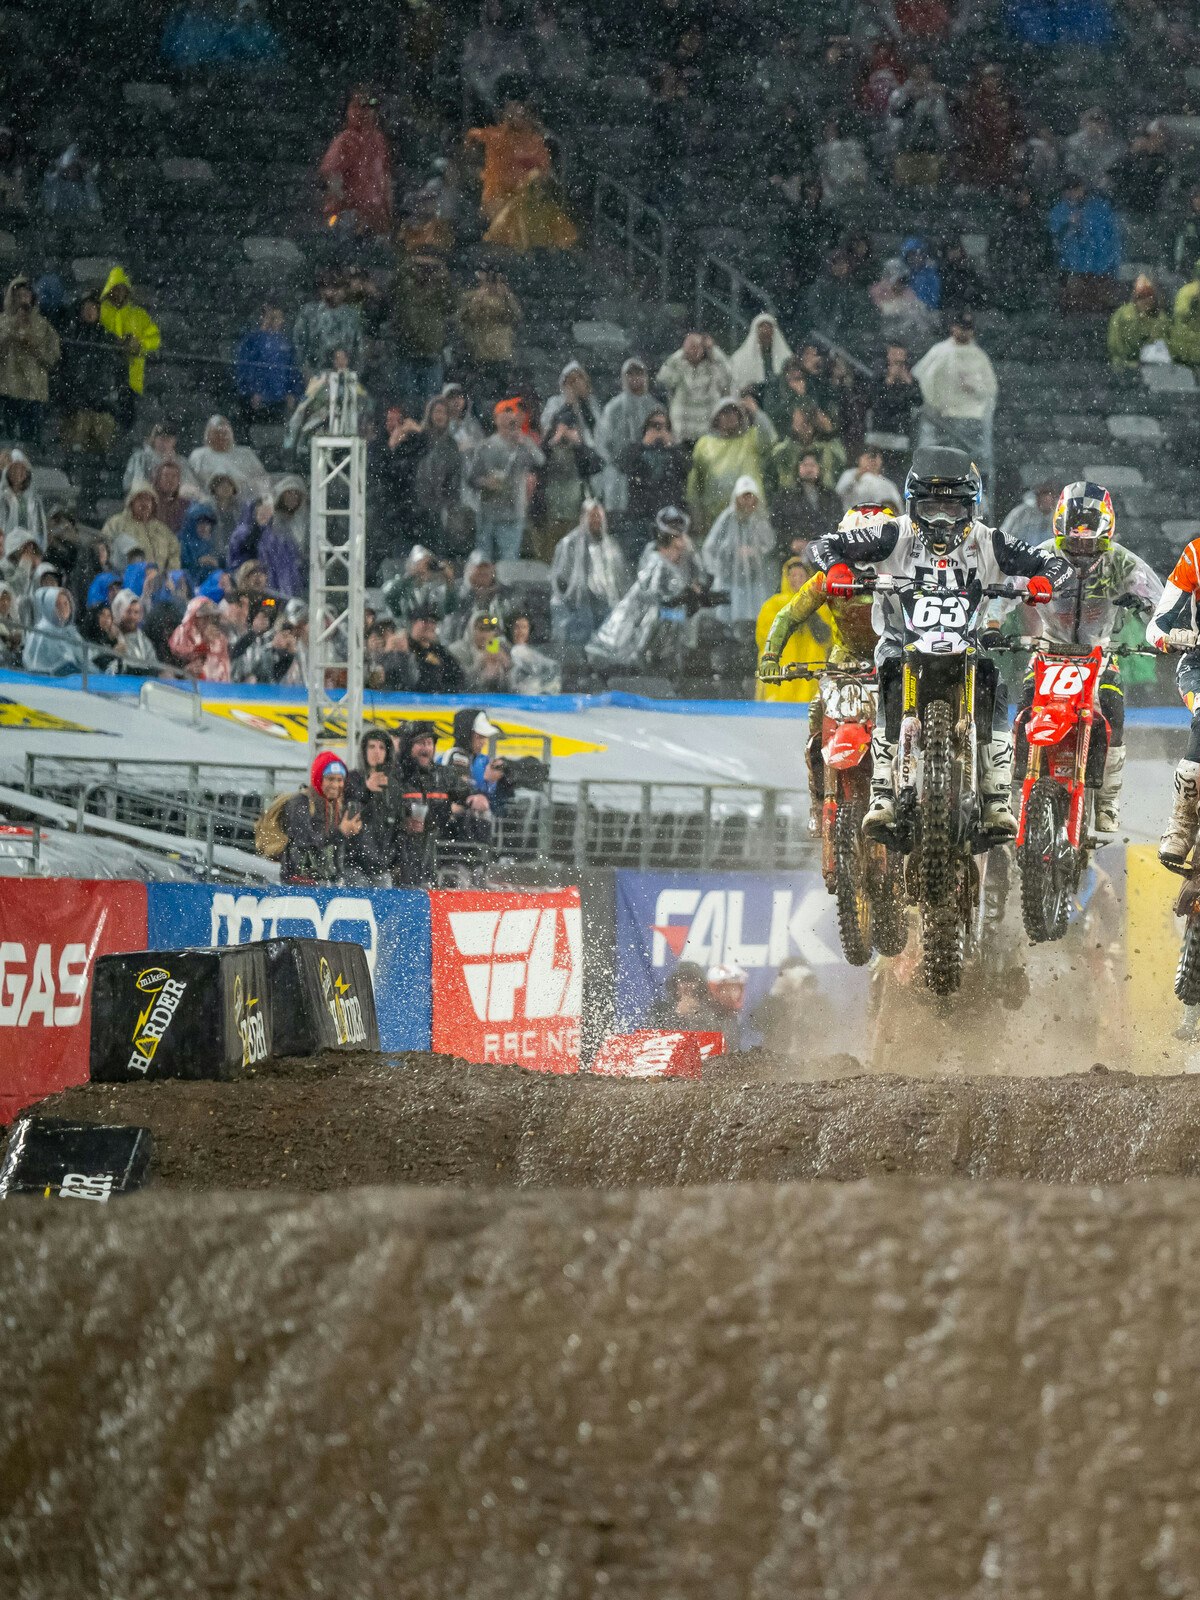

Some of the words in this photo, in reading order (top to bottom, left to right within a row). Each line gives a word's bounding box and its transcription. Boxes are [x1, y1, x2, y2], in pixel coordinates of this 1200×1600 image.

[912, 596, 970, 628] 63
[1039, 665, 1091, 696] 18
[0, 941, 87, 1027] GAS
[139, 971, 168, 987] mike's
[127, 978, 187, 1074] HARDER
[483, 1030, 581, 1061] RACING
